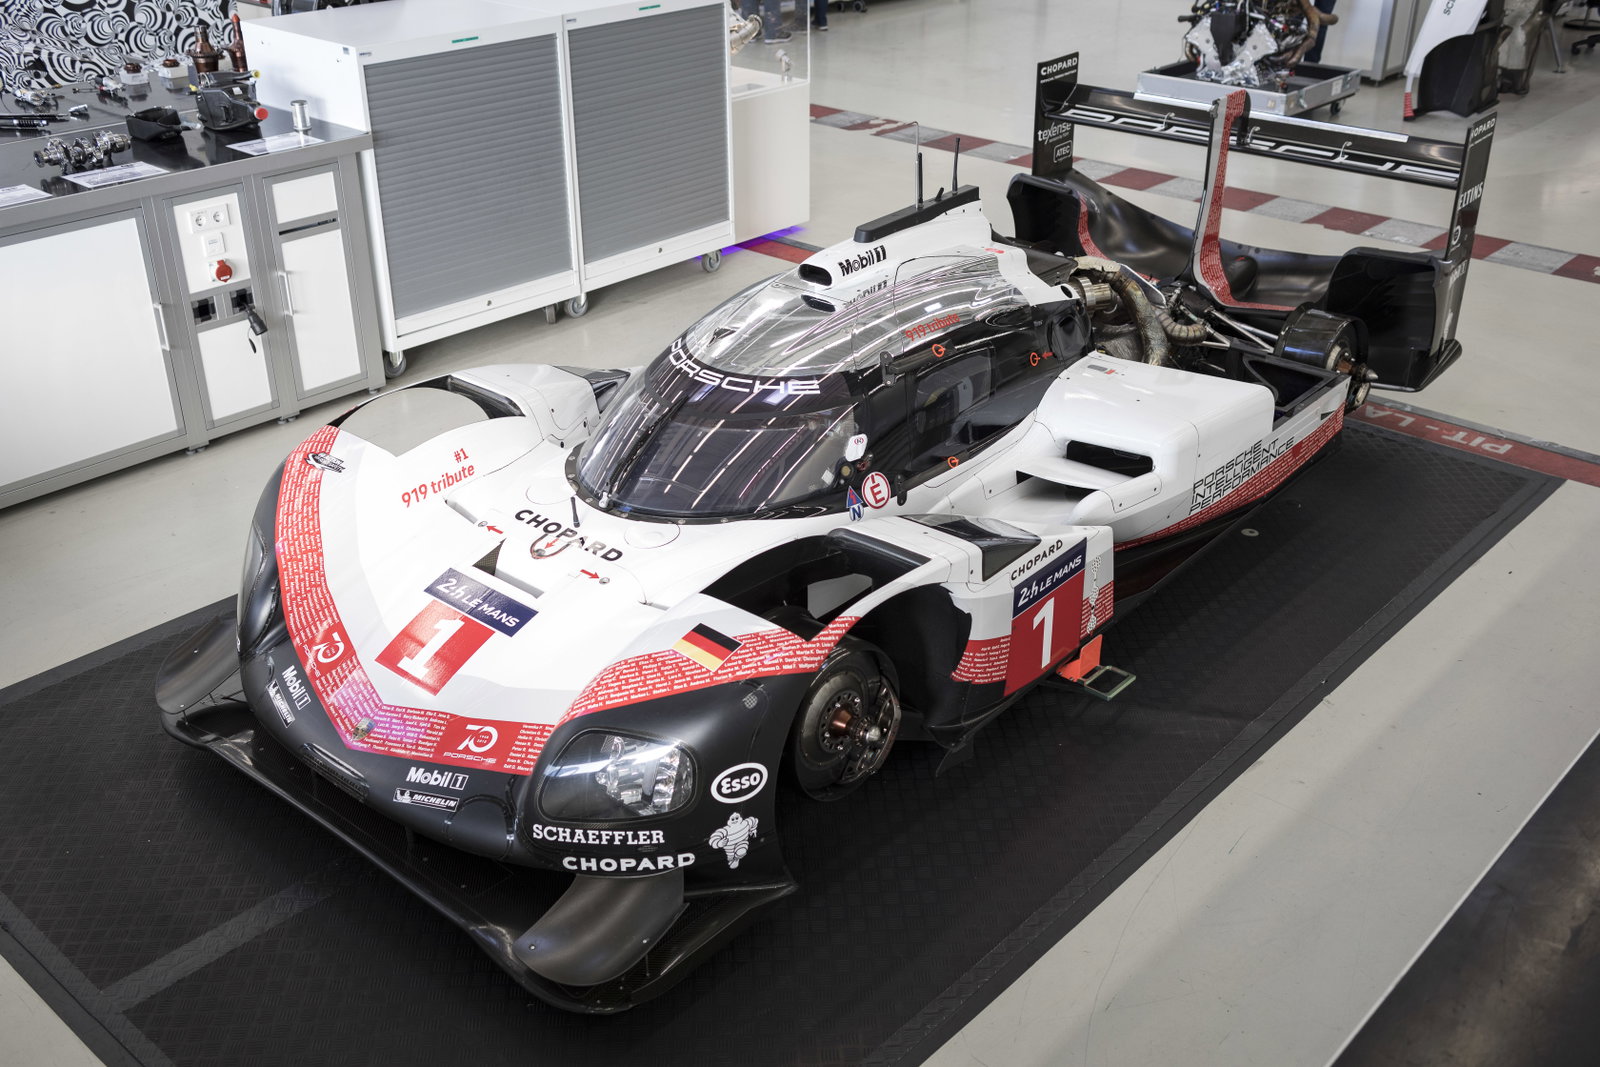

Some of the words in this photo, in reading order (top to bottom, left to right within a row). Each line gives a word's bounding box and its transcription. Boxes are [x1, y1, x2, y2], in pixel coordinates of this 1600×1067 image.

[1041, 57, 1078, 76] CHOPARD
[1056, 145, 1071, 158] ATEC
[838, 250, 875, 277] Mobil
[905, 324, 927, 342] 919
[927, 313, 960, 333] tribute
[669, 337, 821, 395] PORSCHE
[453, 447, 470, 464] #1
[1193, 439, 1263, 494] PORSCHE
[401, 483, 429, 509] 919
[431, 463, 476, 495] tribute
[1189, 436, 1295, 516] PERFORMANCE
[1192, 438, 1280, 505] INTELLIGENT
[870, 482, 886, 505] E
[851, 504, 862, 521] N
[514, 509, 624, 562] CHOPARD
[1011, 540, 1064, 582] CHOPARD
[1040, 577, 1053, 592] LE
[1053, 554, 1083, 579] MANS
[461, 594, 484, 608] LE
[478, 603, 520, 628] MANS
[1032, 596, 1055, 670] 1
[397, 617, 466, 681] 1
[282, 665, 307, 700] Mobil
[274, 693, 293, 724] MICHELIN
[457, 724, 499, 753] 70
[443, 751, 497, 764] PORSCHE
[406, 766, 453, 788] Mobil
[412, 794, 457, 807] MICHELIN
[532, 823, 666, 846] SCHAEFFLER
[562, 852, 696, 872] CHOPARD
